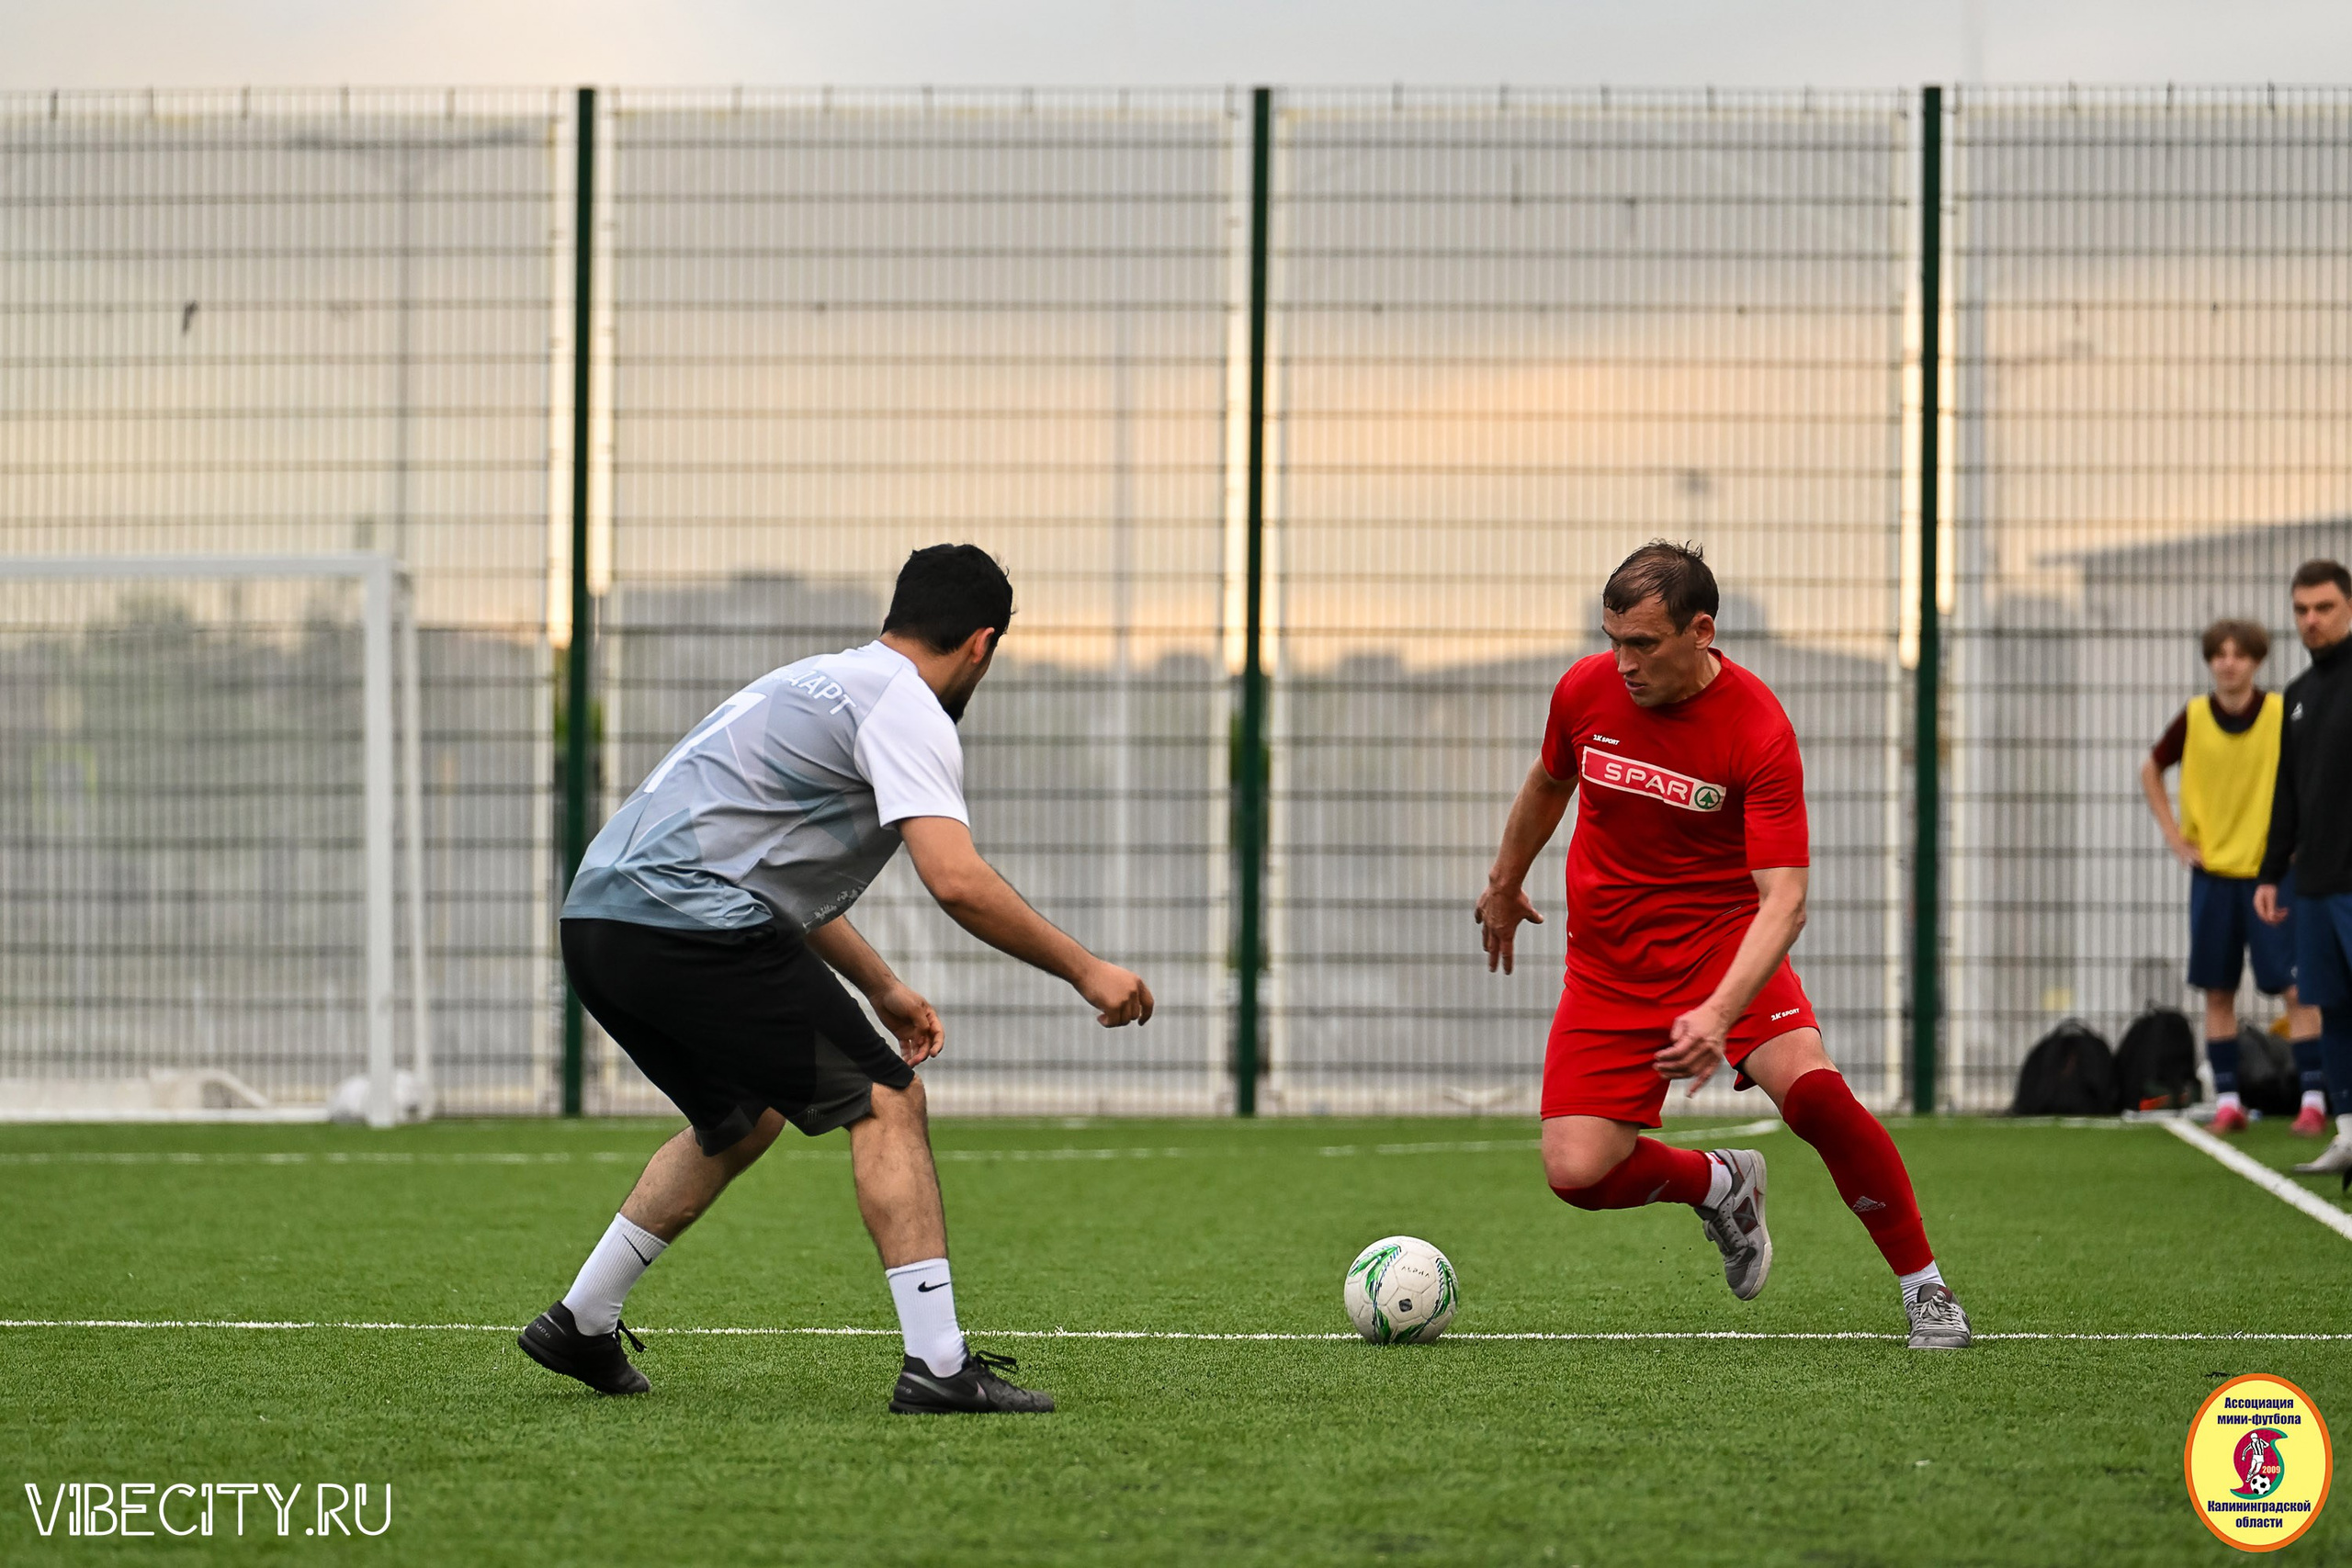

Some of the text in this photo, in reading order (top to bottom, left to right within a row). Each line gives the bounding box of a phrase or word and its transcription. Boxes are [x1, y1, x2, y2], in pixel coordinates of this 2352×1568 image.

[1601, 737, 1620, 745] SPORT
[1604, 762, 1689, 801] SPAR
[1781, 1008, 1800, 1018] SPORT
